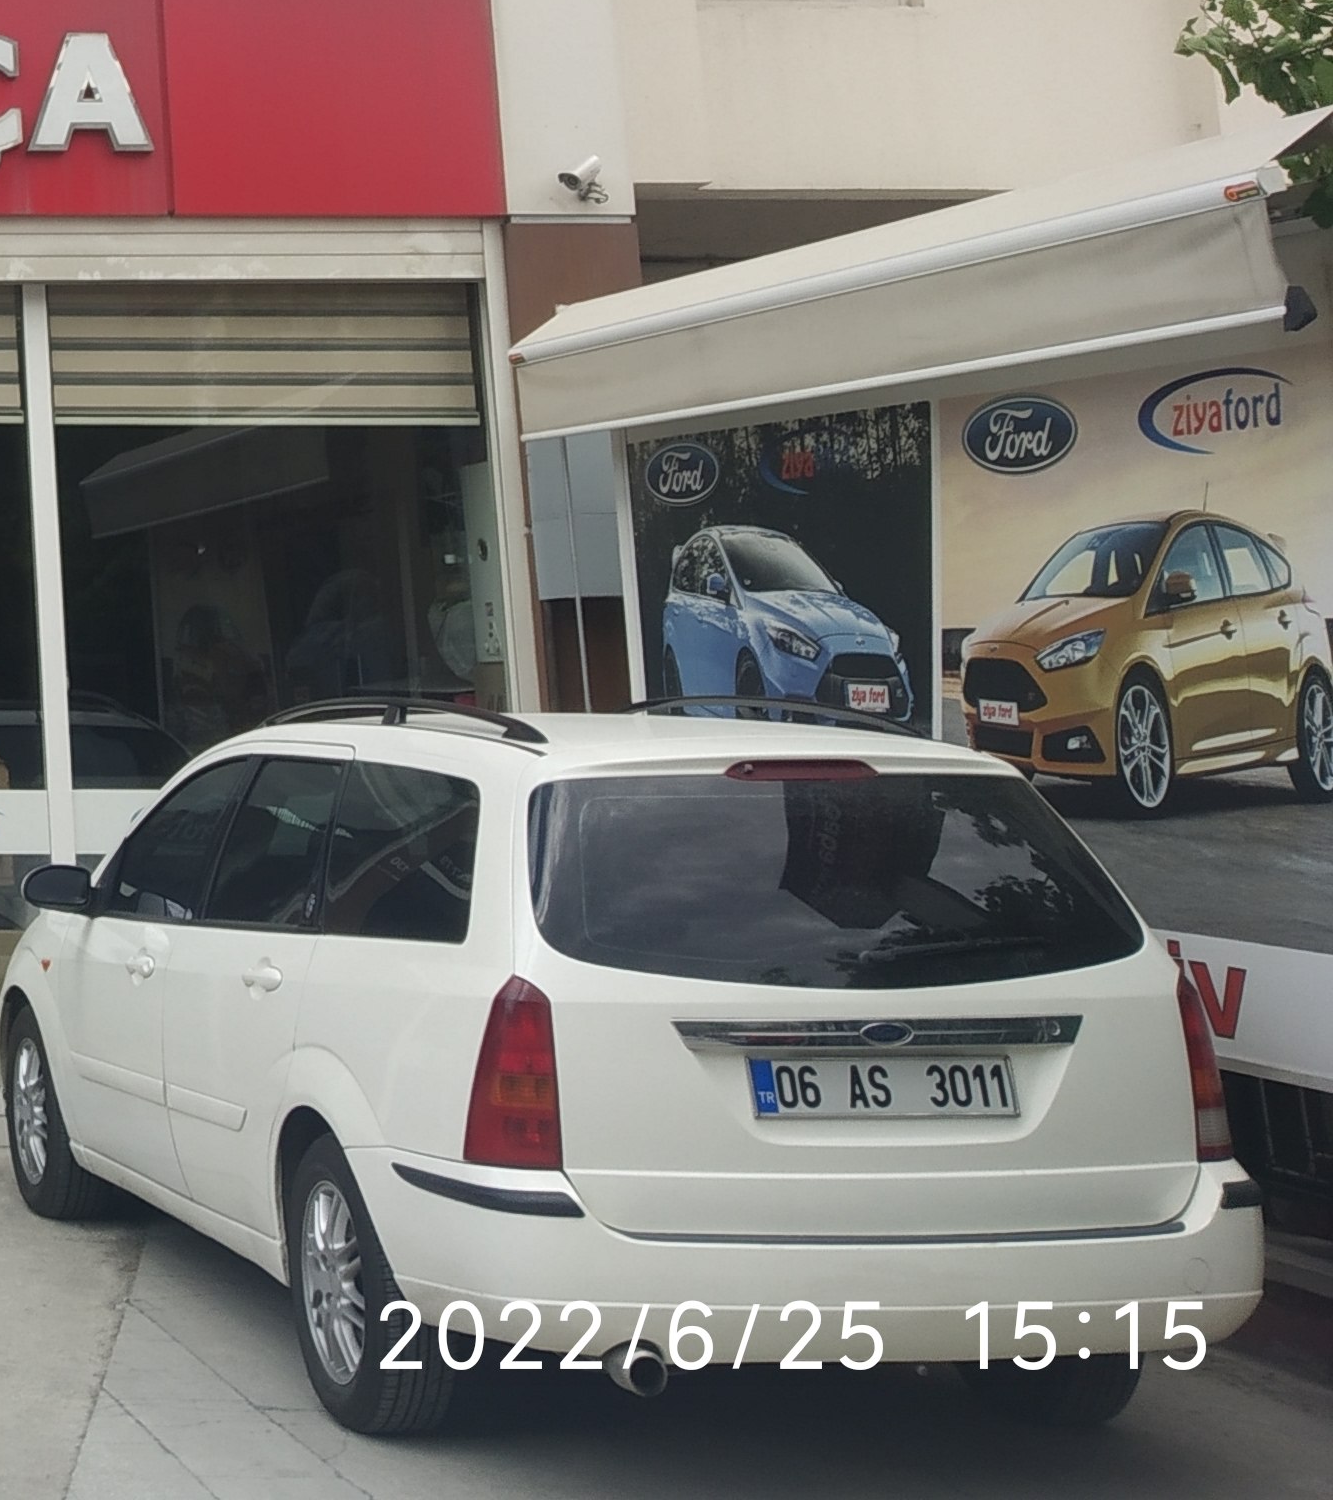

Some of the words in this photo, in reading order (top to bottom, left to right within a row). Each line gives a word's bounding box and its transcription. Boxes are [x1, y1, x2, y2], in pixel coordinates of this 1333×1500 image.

[1171, 384, 1282, 438] ziyaford
[984, 408, 1053, 459] Ford
[658, 451, 704, 495] Ford
[757, 1092, 775, 1104] TR
[775, 1064, 822, 1108] 06
[848, 1066, 893, 1108] AS
[925, 1064, 1010, 1108] 3011
